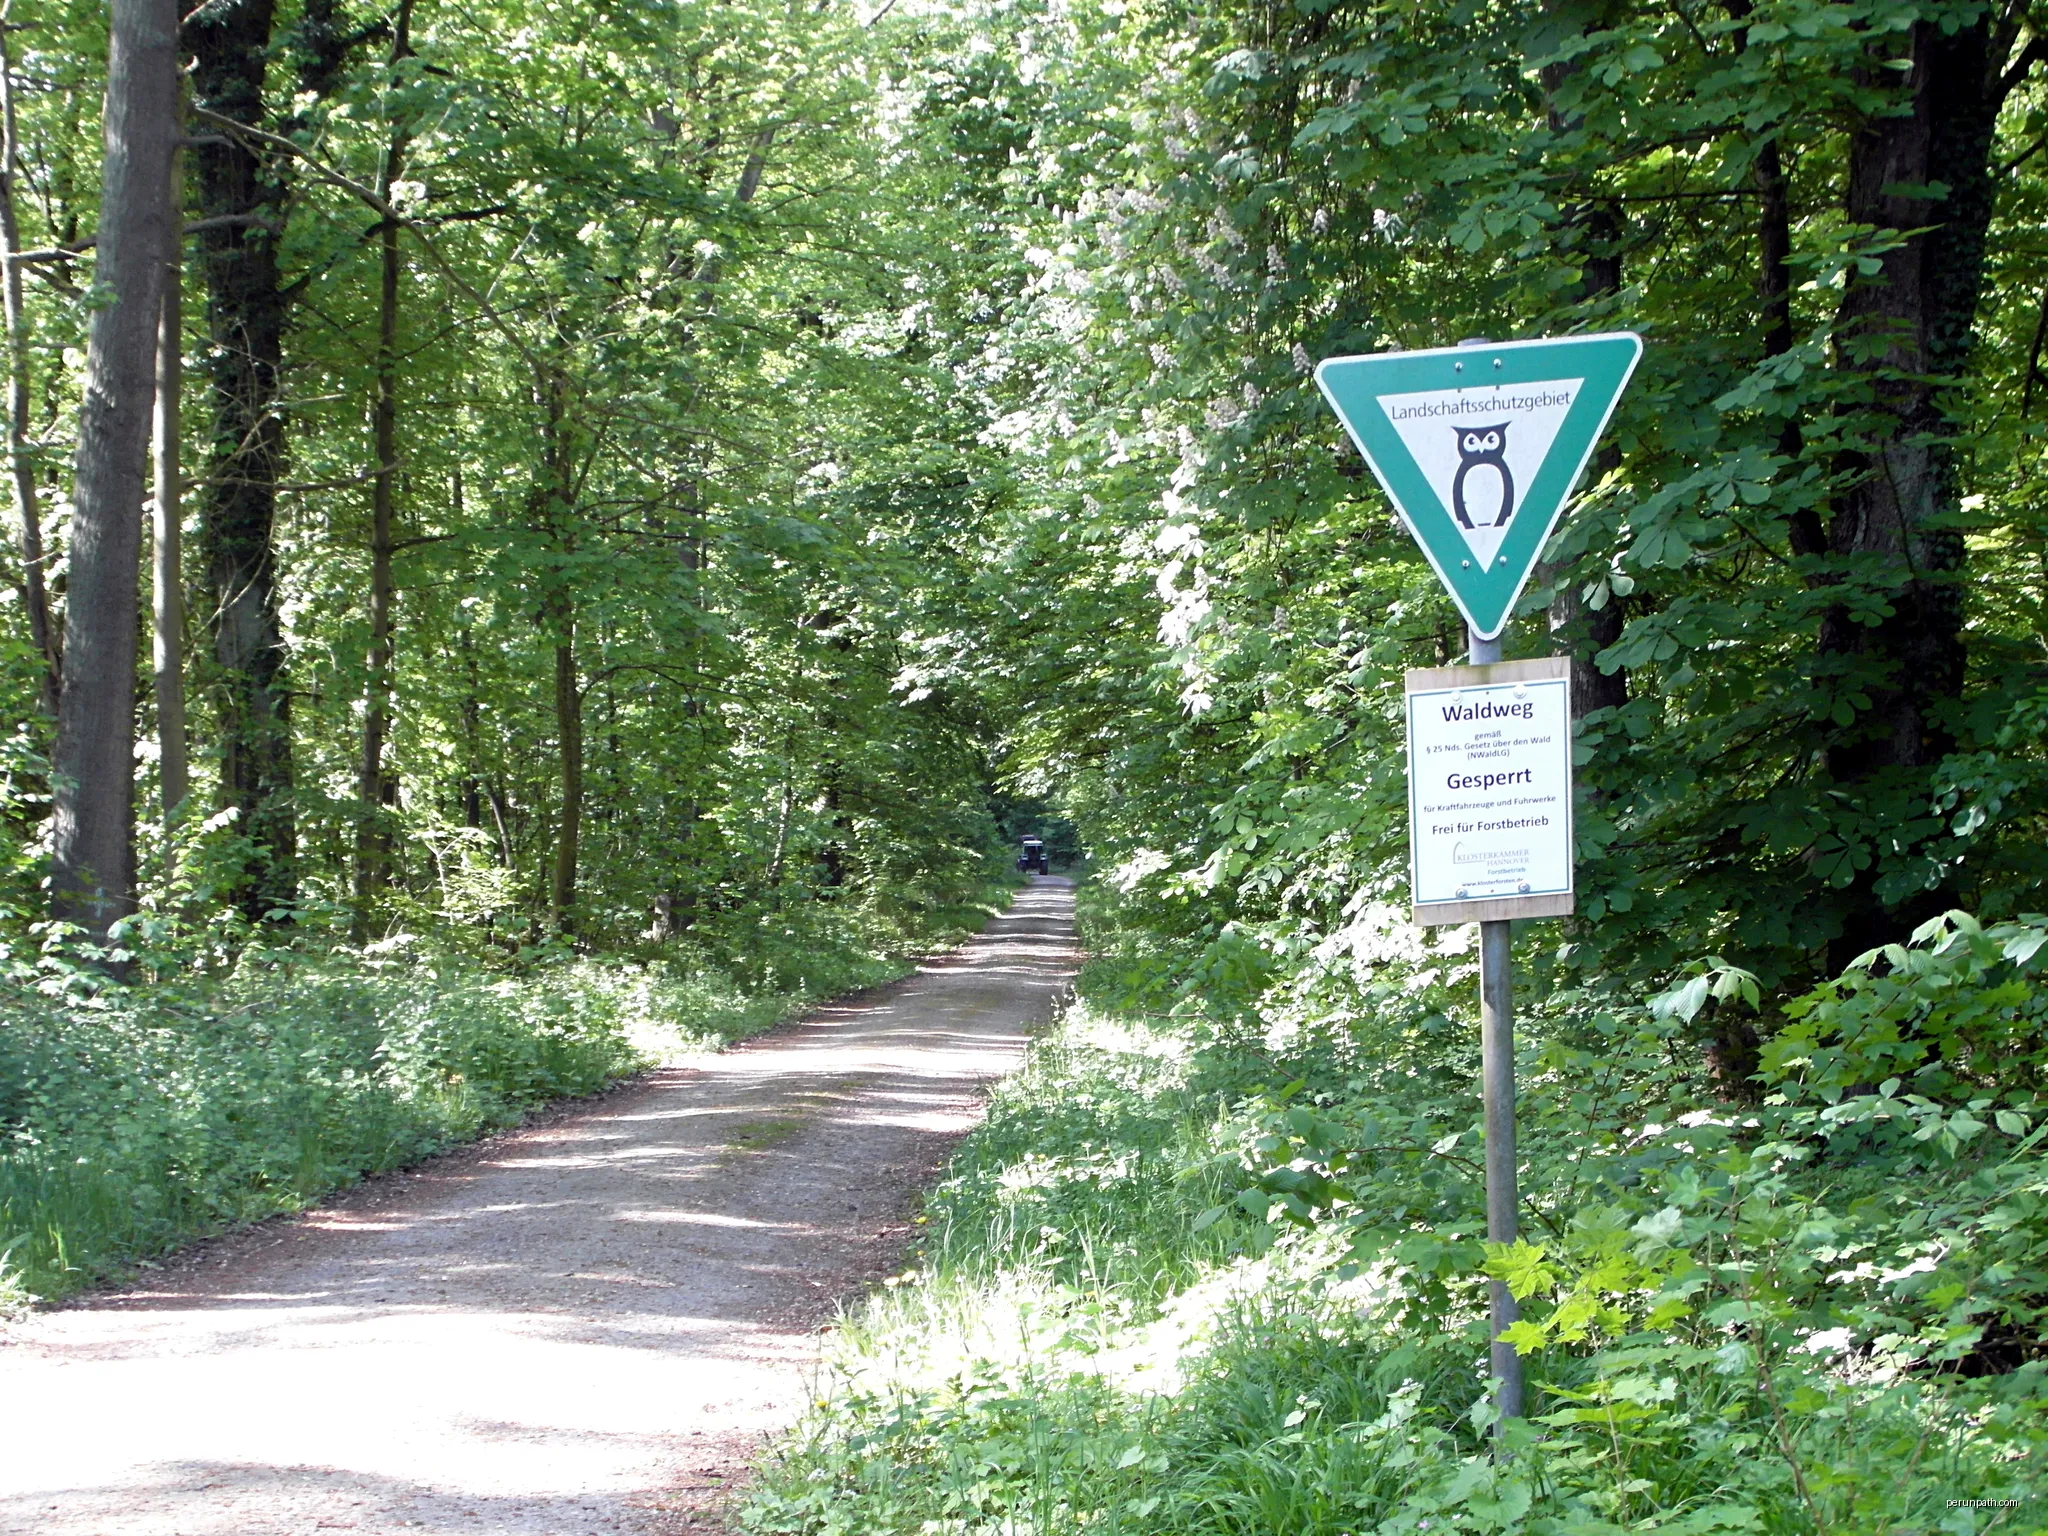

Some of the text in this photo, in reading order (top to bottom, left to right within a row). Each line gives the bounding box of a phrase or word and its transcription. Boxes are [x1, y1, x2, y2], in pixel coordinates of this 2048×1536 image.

[1392, 391, 1571, 420] Landschaftsschutzgebiet
[1442, 702, 1533, 722] Waldweg
[1474, 730, 1502, 741] gemäß
[1426, 736, 1551, 754] § 25 Nds. Gesetz über den Wald
[1467, 750, 1510, 760] (NWaldLG)
[1447, 768, 1532, 790] Gesperrt
[1424, 795, 1556, 813] für Kraftfahrzeuge und Fuhrwerke
[1432, 815, 1549, 835] Frei für Forstbetrieb
[1457, 849, 1530, 862] KLOSTERKAMMER
[1487, 857, 1530, 866] HANNOVER
[1487, 867, 1526, 875] Forstbetrieb
